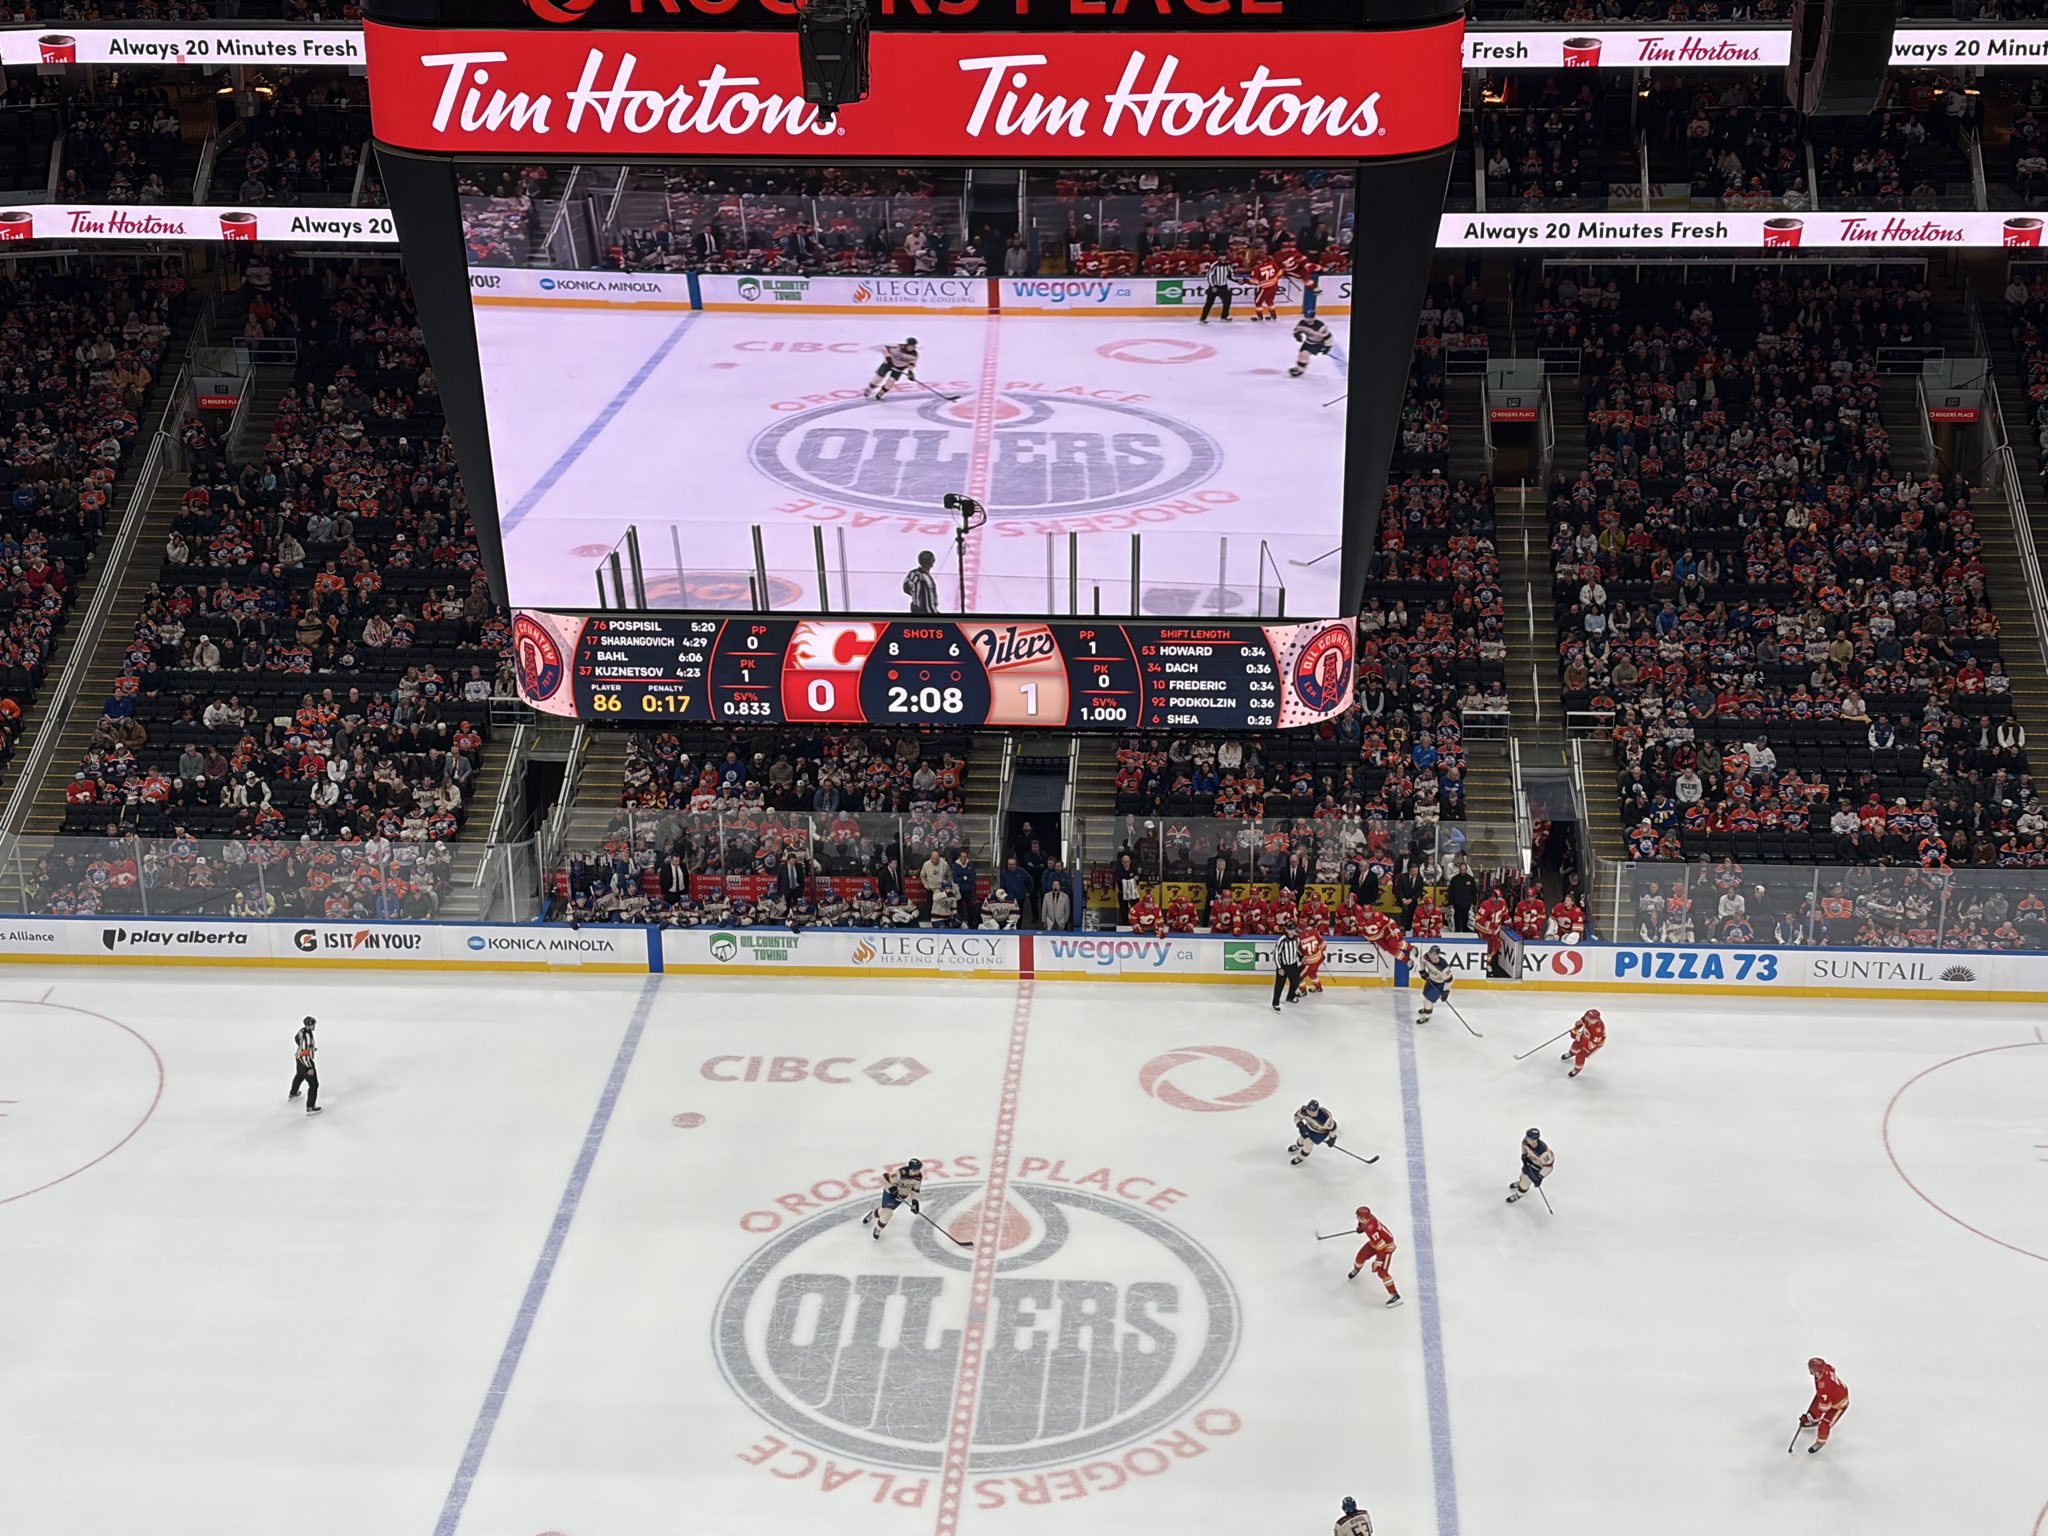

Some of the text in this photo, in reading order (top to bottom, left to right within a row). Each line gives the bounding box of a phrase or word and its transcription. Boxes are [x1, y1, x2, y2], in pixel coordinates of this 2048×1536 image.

[109, 38, 358, 61] Always 20 Minutes Fresh
[1472, 41, 1528, 59] Fresh
[1638, 36, 1759, 62] Tim Hortons
[1954, 40, 1980, 57] 20
[420, 51, 551, 133] Tim
[959, 50, 1381, 138] Tim Hortons
[67, 210, 184, 235] Tim Hortons
[291, 216, 393, 238] Always 20
[1840, 217, 1963, 242] Tim Hortons
[1464, 221, 1728, 243] Always 20 Minutes Fresh
[557, 280, 662, 293] KONICA MINOLTA
[877, 281, 973, 296] LEGACY
[1013, 281, 1113, 303] wegovy
[734, 341, 860, 353] CIBC
[796, 428, 1164, 506] OILERS
[593, 621, 715, 633] 76 POSPISIL 5:20
[751, 626, 767, 636] PP
[903, 629, 944, 640] SHOTS
[1160, 629, 1230, 640] SHIFT LENGTH
[519, 623, 555, 660] COUNTRY
[586, 636, 707, 648] 17 SHARANGOVICH 4:29
[747, 636, 759, 649] 0
[1079, 631, 1095, 640] PP
[889, 642, 960, 656] 8 6
[971, 626, 1054, 667] Oilers
[1088, 641, 1097, 655] 1
[1142, 646, 1265, 657] 53 HOWARD 0:34
[584, 650, 703, 663] 7 BAHL 6:06
[1302, 651, 1318, 670] OIL
[579, 666, 701, 678] 37 KUZNETSOV 4:23
[740, 660, 755, 669] PK
[1093, 665, 1108, 674] PK
[1147, 663, 1271, 674] 34 DACH 0:36
[741, 669, 749, 683] 1
[1098, 674, 1110, 689] 0
[591, 683, 683, 693] PLAYER PENALTY
[1152, 680, 1274, 692] 10 FREDERIC 0:34
[733, 692, 758, 702] SV%
[807, 679, 835, 712] 0
[888, 686, 963, 713] 2:08
[1020, 682, 1037, 715] 1
[1092, 698, 1117, 707] SV%
[1152, 697, 1275, 709] 92 PODKOLZIN 0:36
[593, 694, 690, 713] 86 0:17
[724, 702, 771, 716] 0.833
[1080, 707, 1127, 722] 1.000
[1152, 714, 1272, 726] 6 SHEA 0:25
[9, 930, 55, 942] Alliance
[130, 930, 248, 945] play alberta
[381, 934, 422, 949] YOU?
[757, 936, 799, 949] COUNTRY
[488, 938, 615, 951] KONICA MINOLTA
[881, 937, 1003, 957] LEGACY
[753, 949, 788, 961] TOWING
[880, 955, 933, 963] HEATING
[949, 956, 1003, 965] COOLING
[1050, 939, 1173, 967] wegovy
[1615, 951, 1778, 981] PIZZA 73
[1813, 959, 1933, 981] SUNTAIL
[700, 1055, 857, 1084] CIBC
[1017, 1156, 1189, 1212] PLACE
[764, 1273, 1180, 1445] OILERS
[735, 1434, 930, 1508] PLACE
